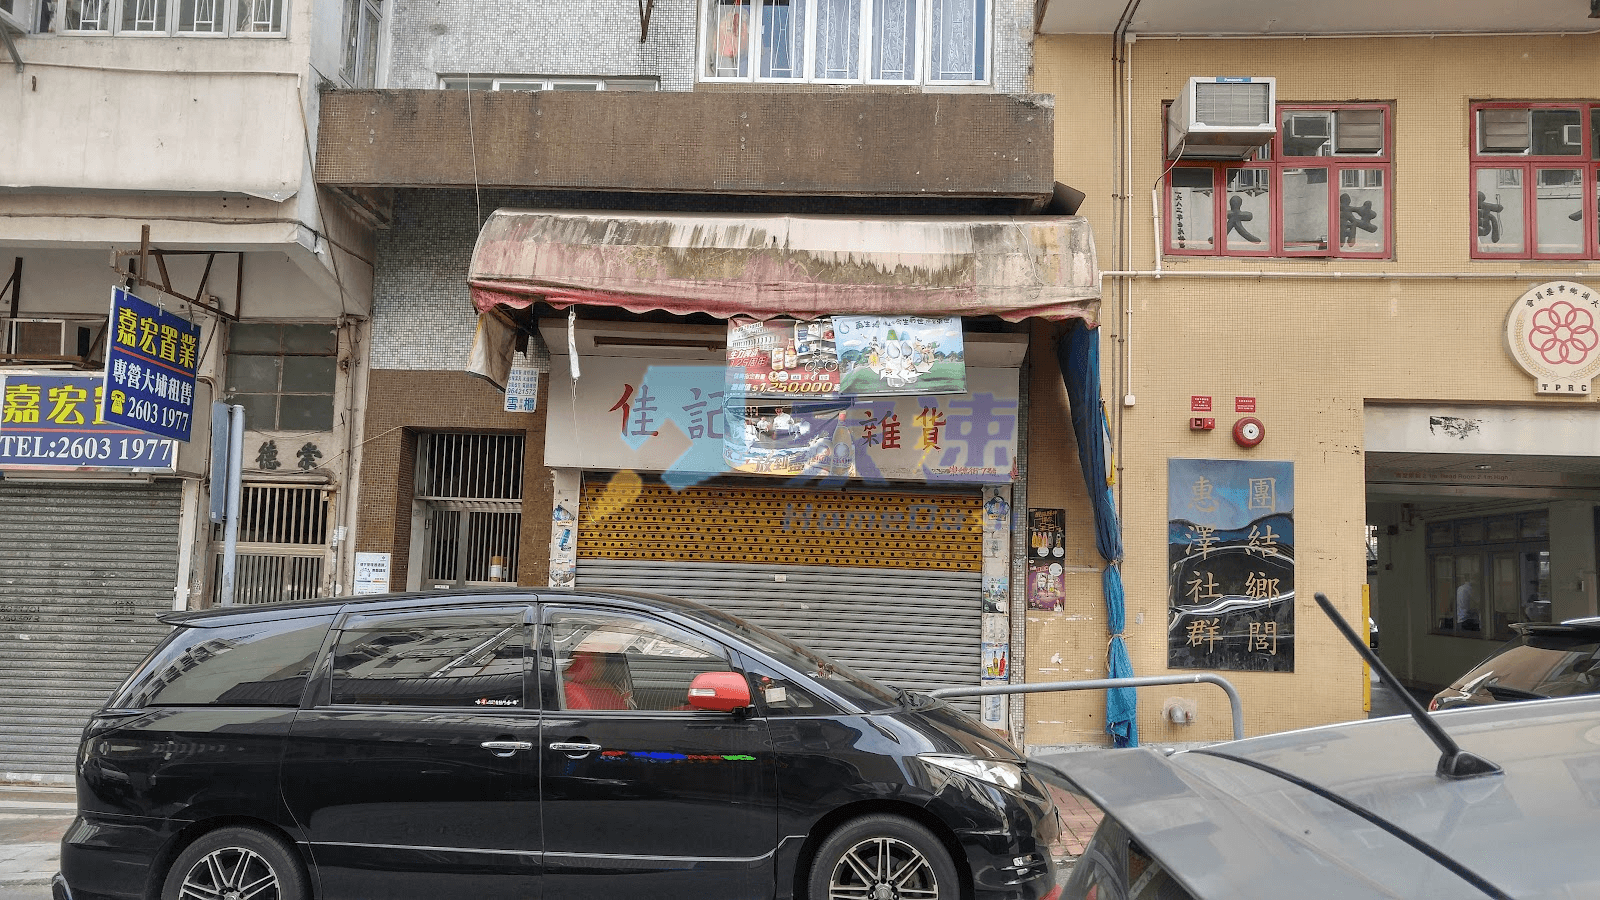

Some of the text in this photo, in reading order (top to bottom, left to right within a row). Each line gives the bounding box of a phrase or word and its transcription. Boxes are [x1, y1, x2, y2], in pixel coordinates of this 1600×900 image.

[117, 307, 197, 369] 嘉宏置業
[3, 384, 107, 425] 嘉宏
[113, 358, 193, 406] 專營大埔租售
[751, 381, 833, 393] $1,250,000
[127, 396, 190, 432] 2603 1977
[608, 384, 724, 440] 佳記
[859, 405, 947, 451] 雜貨
[0, 436, 173, 461] TEL:2603 1977
[1184, 475, 1224, 655] 惠澤社群
[1244, 477, 1280, 657] 團結鄉閭
